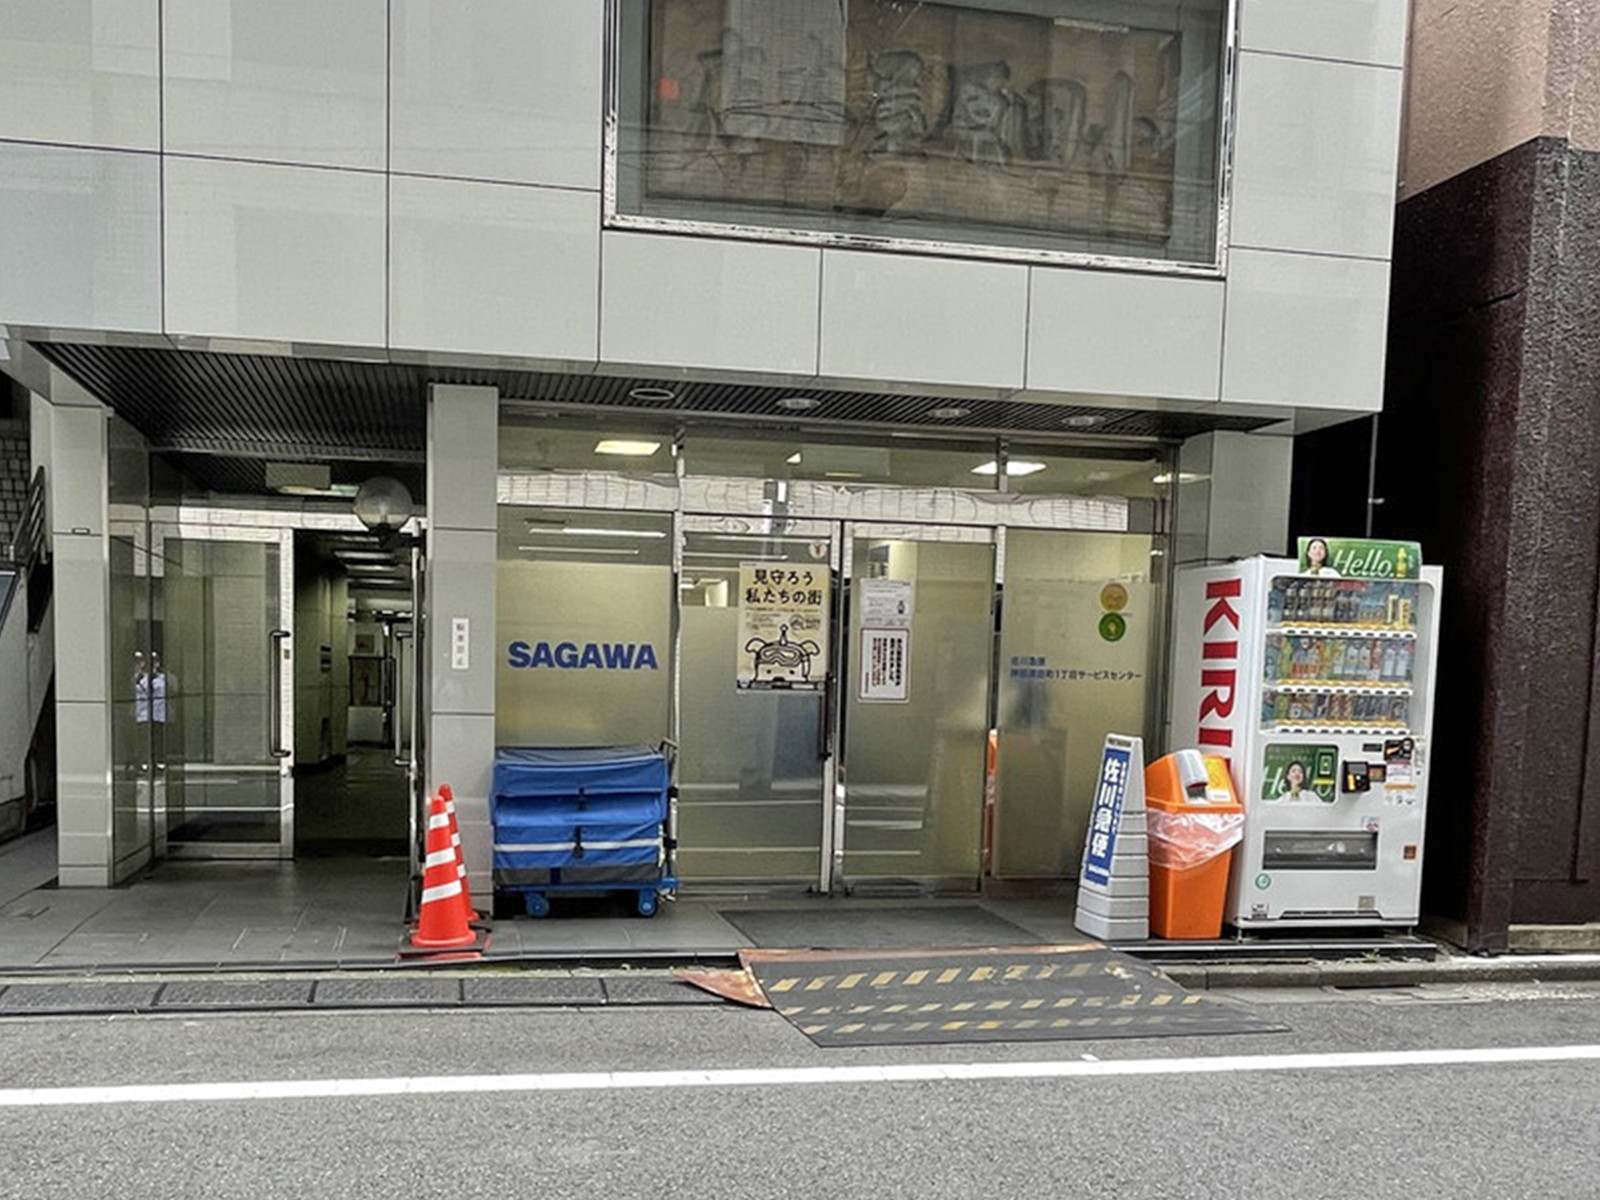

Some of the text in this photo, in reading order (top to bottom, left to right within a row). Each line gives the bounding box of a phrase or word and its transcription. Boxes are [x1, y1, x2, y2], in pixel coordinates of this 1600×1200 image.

[753, 569, 813, 586] 見守ろう
[746, 587, 822, 606] 私たちの街
[508, 641, 658, 669] SAGAWA
[1198, 578, 1242, 775] KIRI
[1091, 757, 1121, 858] 佐川急便
